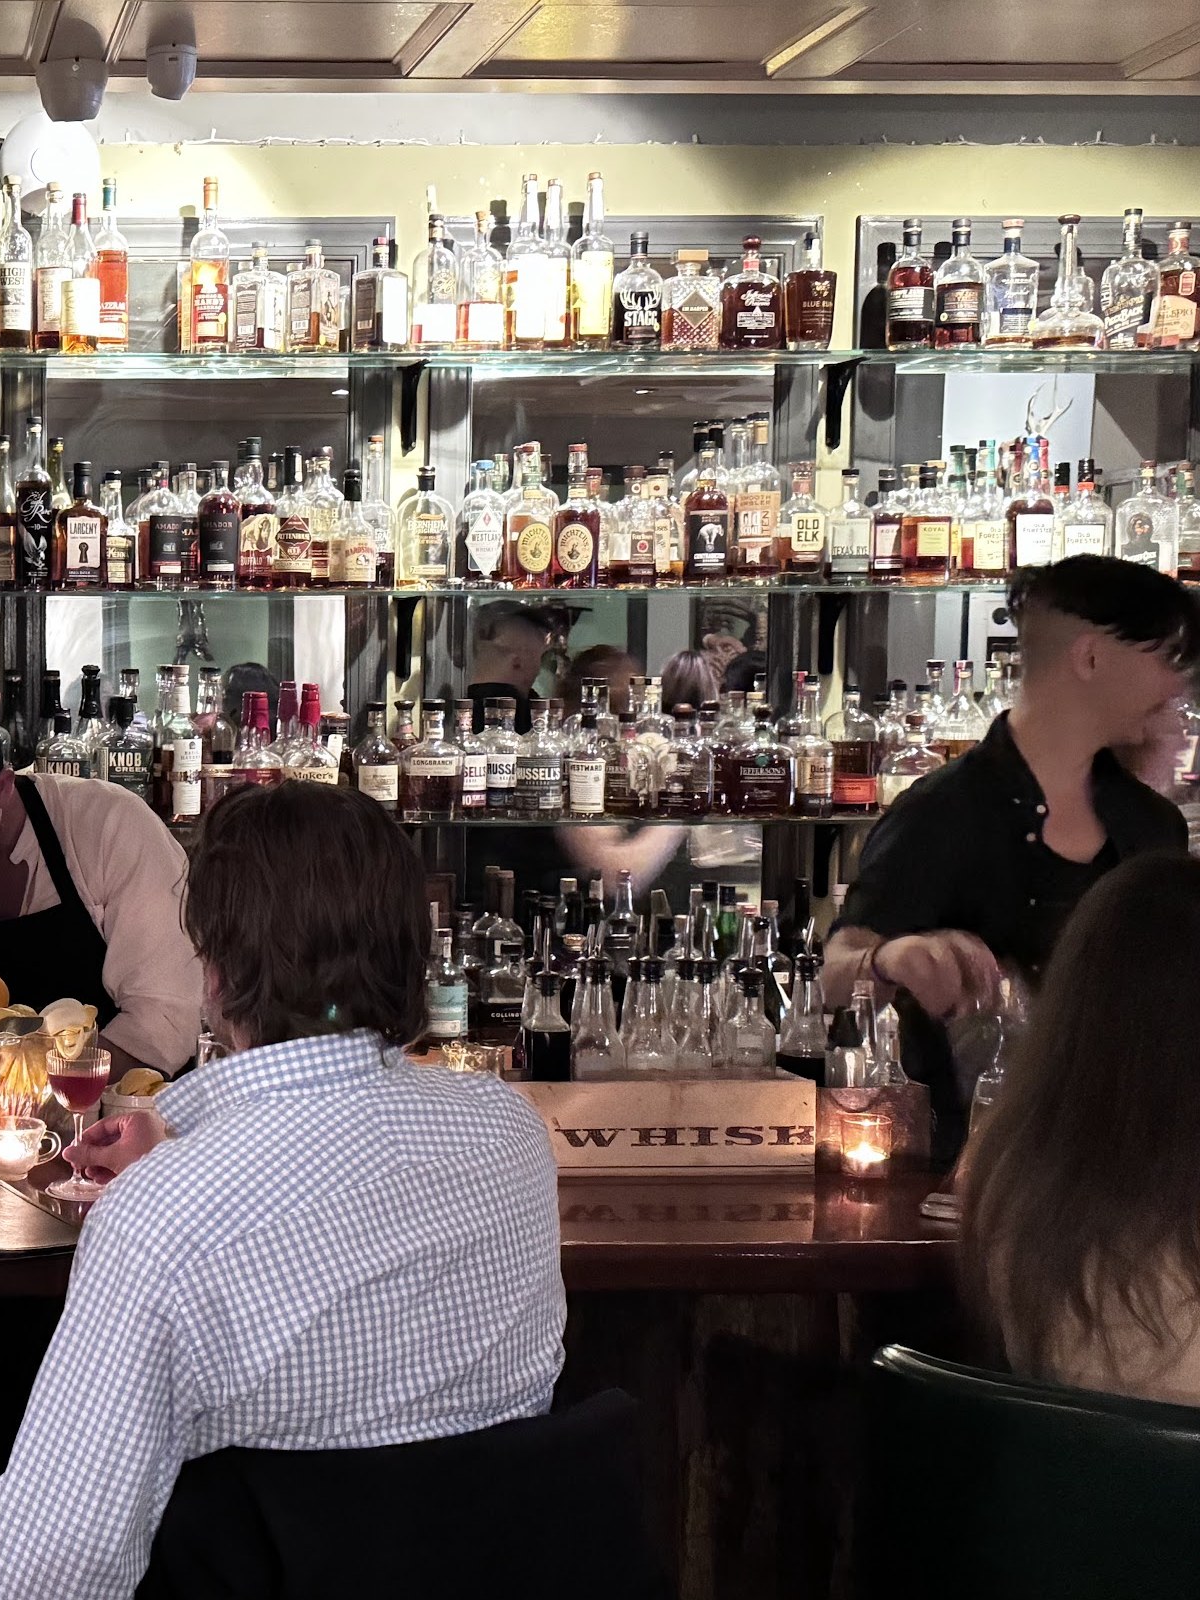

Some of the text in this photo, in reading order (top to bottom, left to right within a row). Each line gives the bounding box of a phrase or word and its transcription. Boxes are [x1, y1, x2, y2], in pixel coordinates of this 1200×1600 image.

[0, 267, 26, 276] HIGH
[0, 277, 25, 286] WEST
[802, 300, 820, 308] BLUE
[624, 310, 657, 326] STAGG
[407, 520, 448, 531] BERNHEIM
[761, 510, 771, 534] TEN
[797, 518, 820, 530] OLD
[69, 522, 98, 535] LARCENY
[521, 527, 550, 546] MICHTER'S
[560, 529, 589, 548] MICHTER'S
[797, 531, 819, 542] ELK
[832, 545, 869, 556] TEXAS RYE
[109, 751, 142, 767] KNOB
[412, 759, 454, 767] LONGBRANCH
[47, 762, 80, 777] KNOB
[115, 765, 148, 774] CREEK
[487, 764, 516, 778] RUSSE
[517, 767, 561, 781] RUSSELL'S
[740, 766, 786, 776] JEFFERSON'S
[293, 770, 334, 782] Maker's
